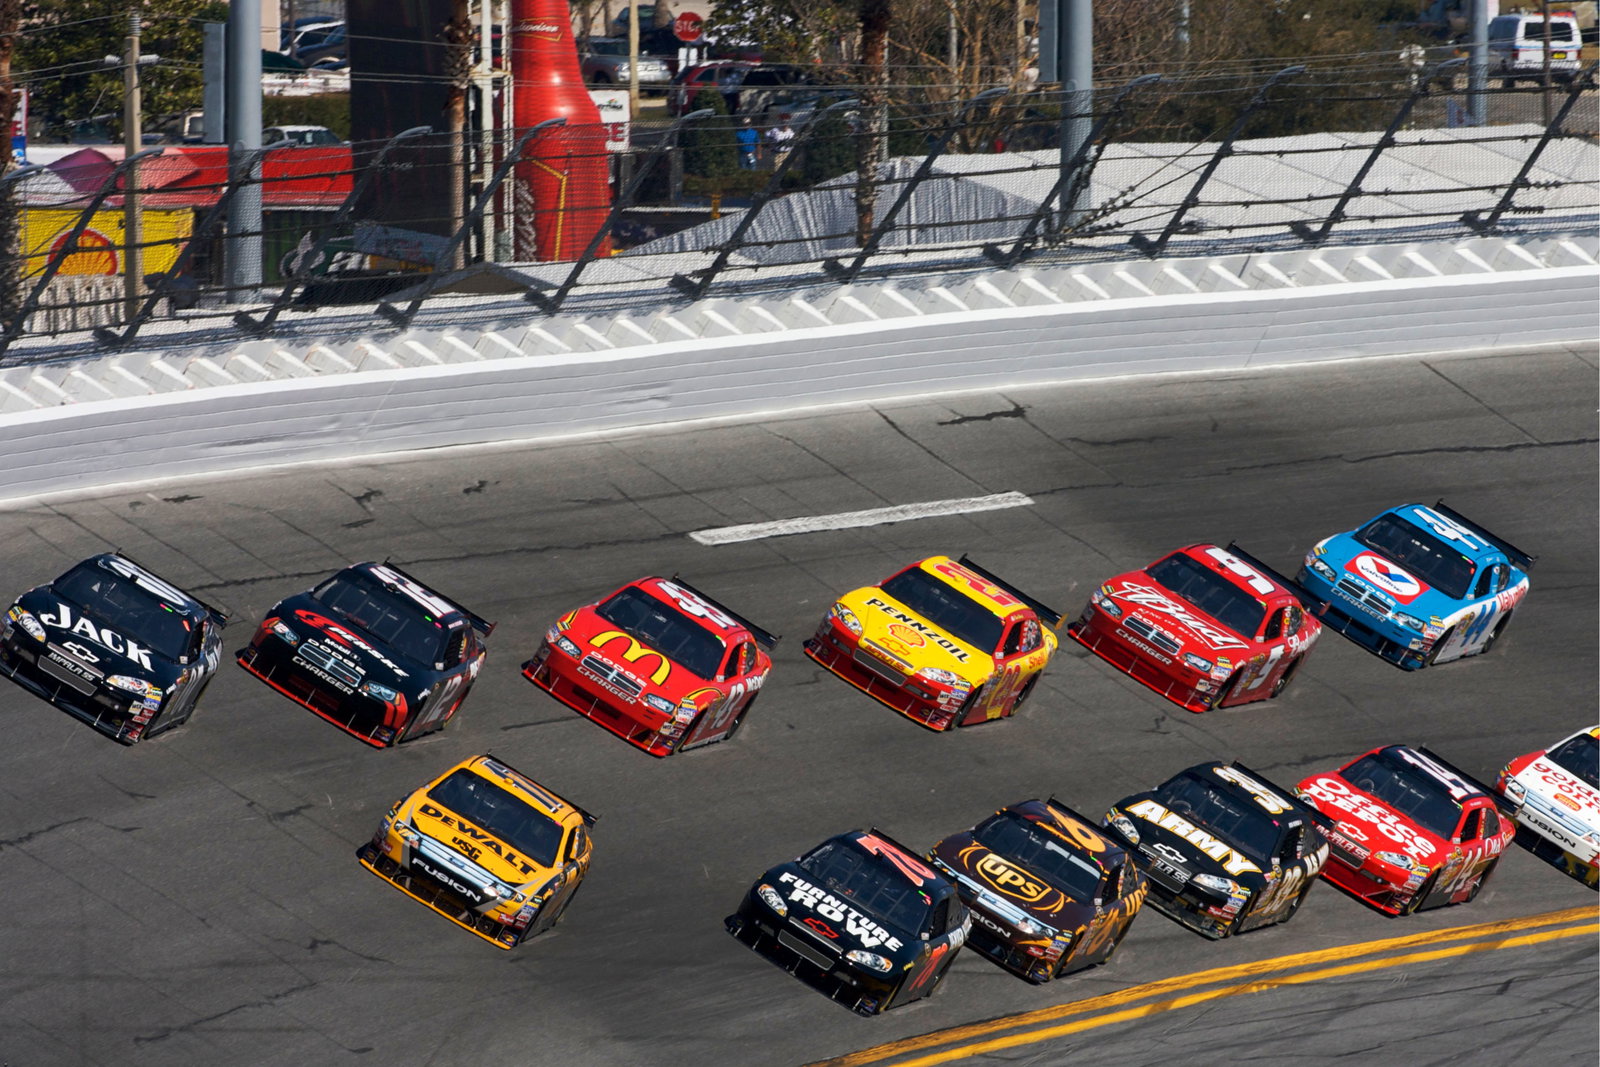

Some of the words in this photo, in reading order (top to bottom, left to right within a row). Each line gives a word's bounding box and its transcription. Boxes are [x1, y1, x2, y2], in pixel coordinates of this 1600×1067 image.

[1344, 573, 1397, 607] DODGE
[1360, 565, 1403, 594] Valvoline
[656, 580, 739, 629] 43
[1330, 587, 1387, 623] CHARGER
[39, 602, 155, 673] JACK
[324, 637, 352, 656] Mobil
[865, 597, 971, 664] PENNZOIL
[1115, 628, 1173, 666] CHARGER
[1132, 611, 1185, 646] DODGE
[47, 651, 82, 675] IMPALA
[81, 671, 96, 682] SS
[307, 638, 367, 676] DODGE
[327, 626, 410, 678] PENSKE
[590, 650, 648, 687] DODGE
[292, 655, 355, 696] CHARGER
[576, 665, 638, 706] CHARGER
[1541, 775, 1599, 815] corr
[1316, 777, 1437, 855] Office
[1519, 809, 1577, 849] FUSION
[418, 803, 537, 876] DEWALT
[451, 836, 483, 861] USG
[1124, 799, 1263, 877] ARMY
[1354, 846, 1371, 860] SS
[411, 857, 482, 902] FUSION
[1172, 872, 1189, 884] SS
[779, 871, 904, 953] FURNITURE
[787, 888, 882, 949] ROW
[969, 908, 1012, 939] SION
